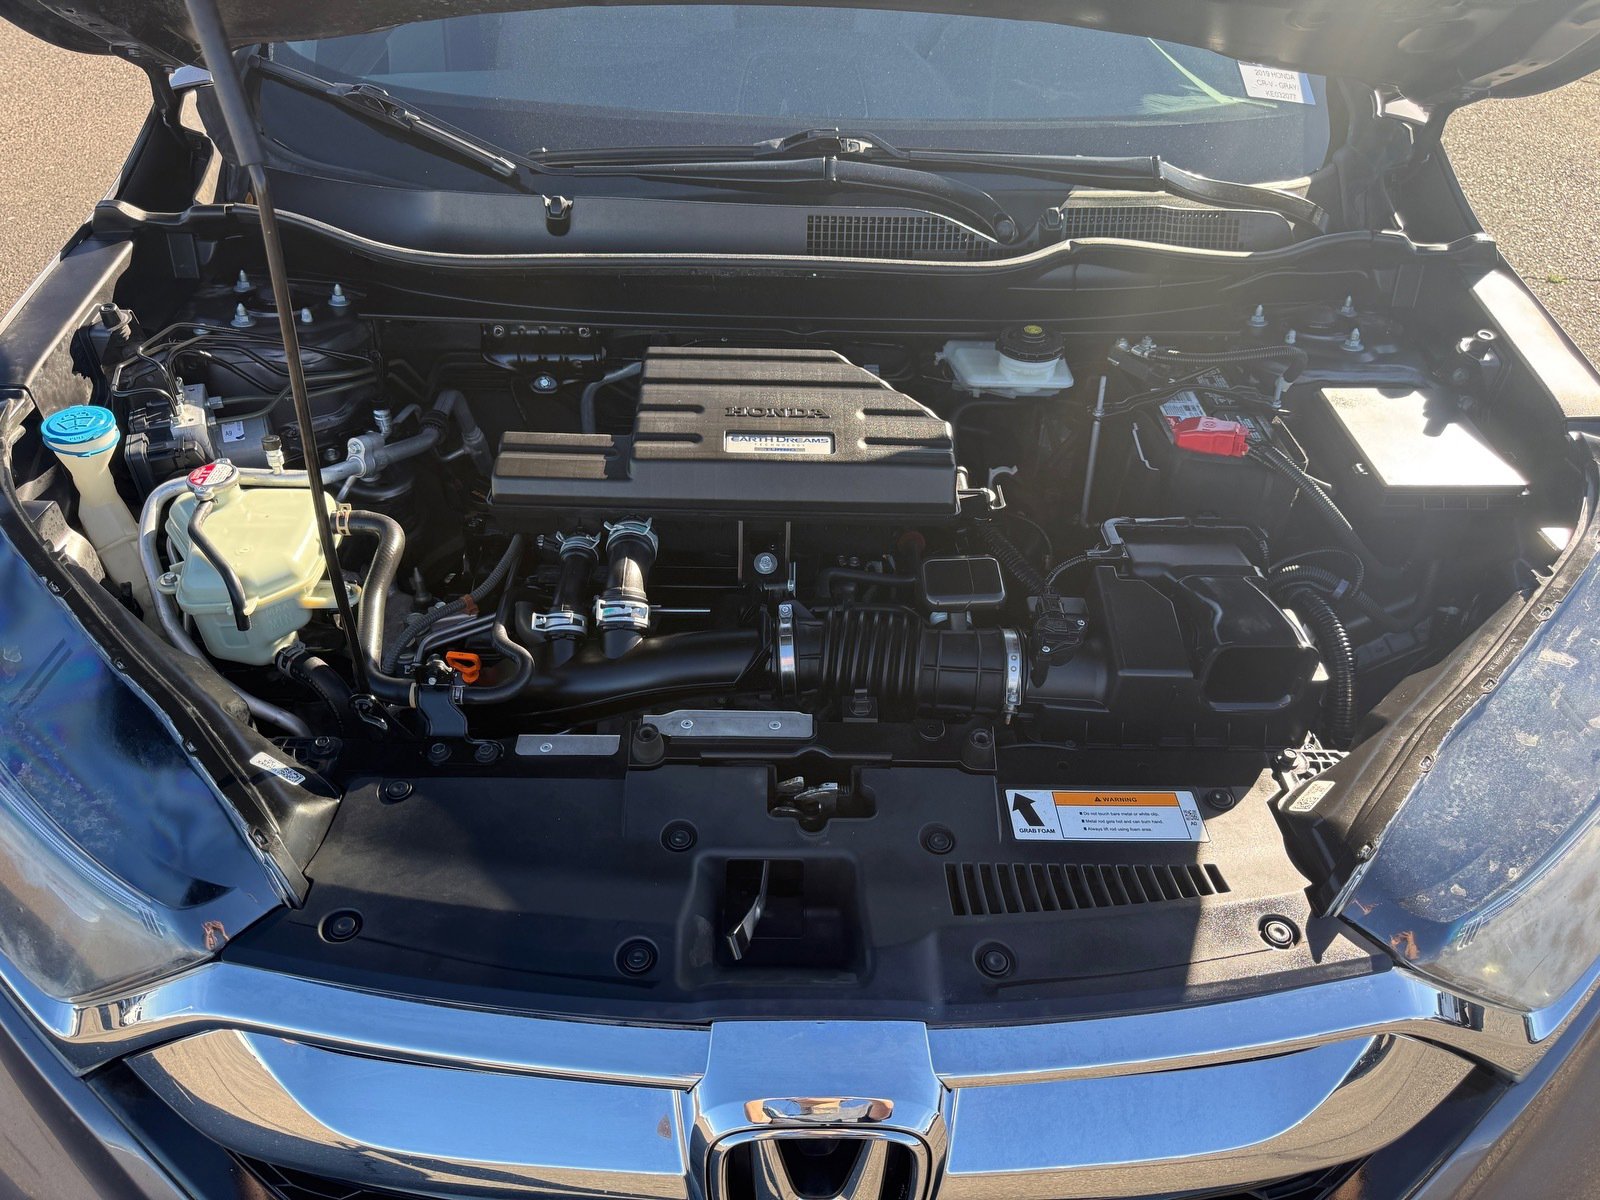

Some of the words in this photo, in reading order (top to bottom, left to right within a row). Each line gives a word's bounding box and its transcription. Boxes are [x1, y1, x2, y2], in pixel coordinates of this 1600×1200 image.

[1255, 69, 1270, 77] 2019
[1271, 71, 1296, 80] HONDA
[1256, 79, 1273, 87] CR-V
[1278, 82, 1297, 90] GRAY
[724, 406, 832, 419] HONDA
[731, 435, 773, 443] EARTH
[776, 436, 829, 444] DREAMS
